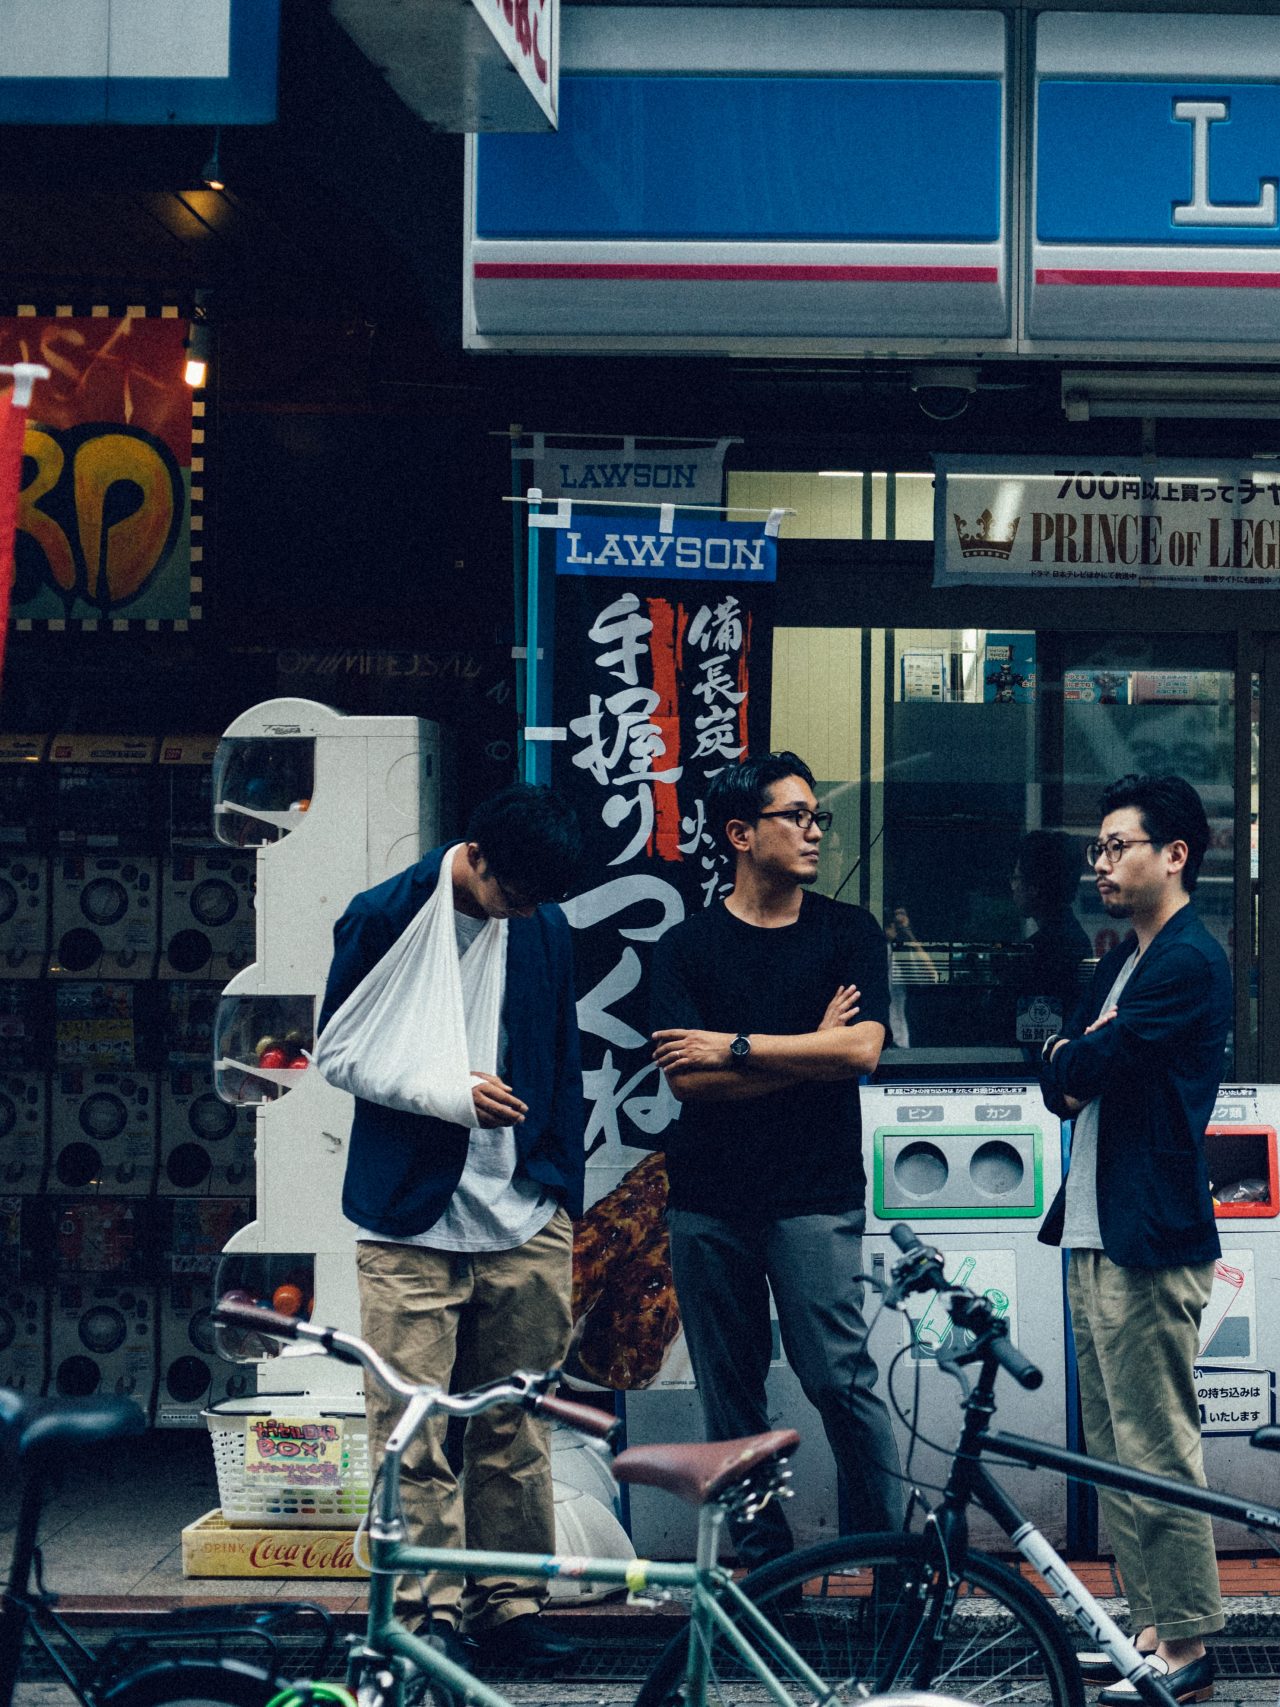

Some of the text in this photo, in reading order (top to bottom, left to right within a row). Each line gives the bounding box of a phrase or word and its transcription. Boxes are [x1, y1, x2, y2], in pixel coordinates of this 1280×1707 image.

[559, 463, 698, 489] LAWSON
[1029, 511, 1163, 566] PRINCE
[1168, 529, 1201, 567] OF
[566, 532, 766, 570] LAWSON
[908, 1107, 1011, 1119] ビン カン
[1197, 1387, 1261, 1399] の持ち込みは
[1209, 1410, 1260, 1422] いたします
[204, 1543, 246, 1554] DRINK
